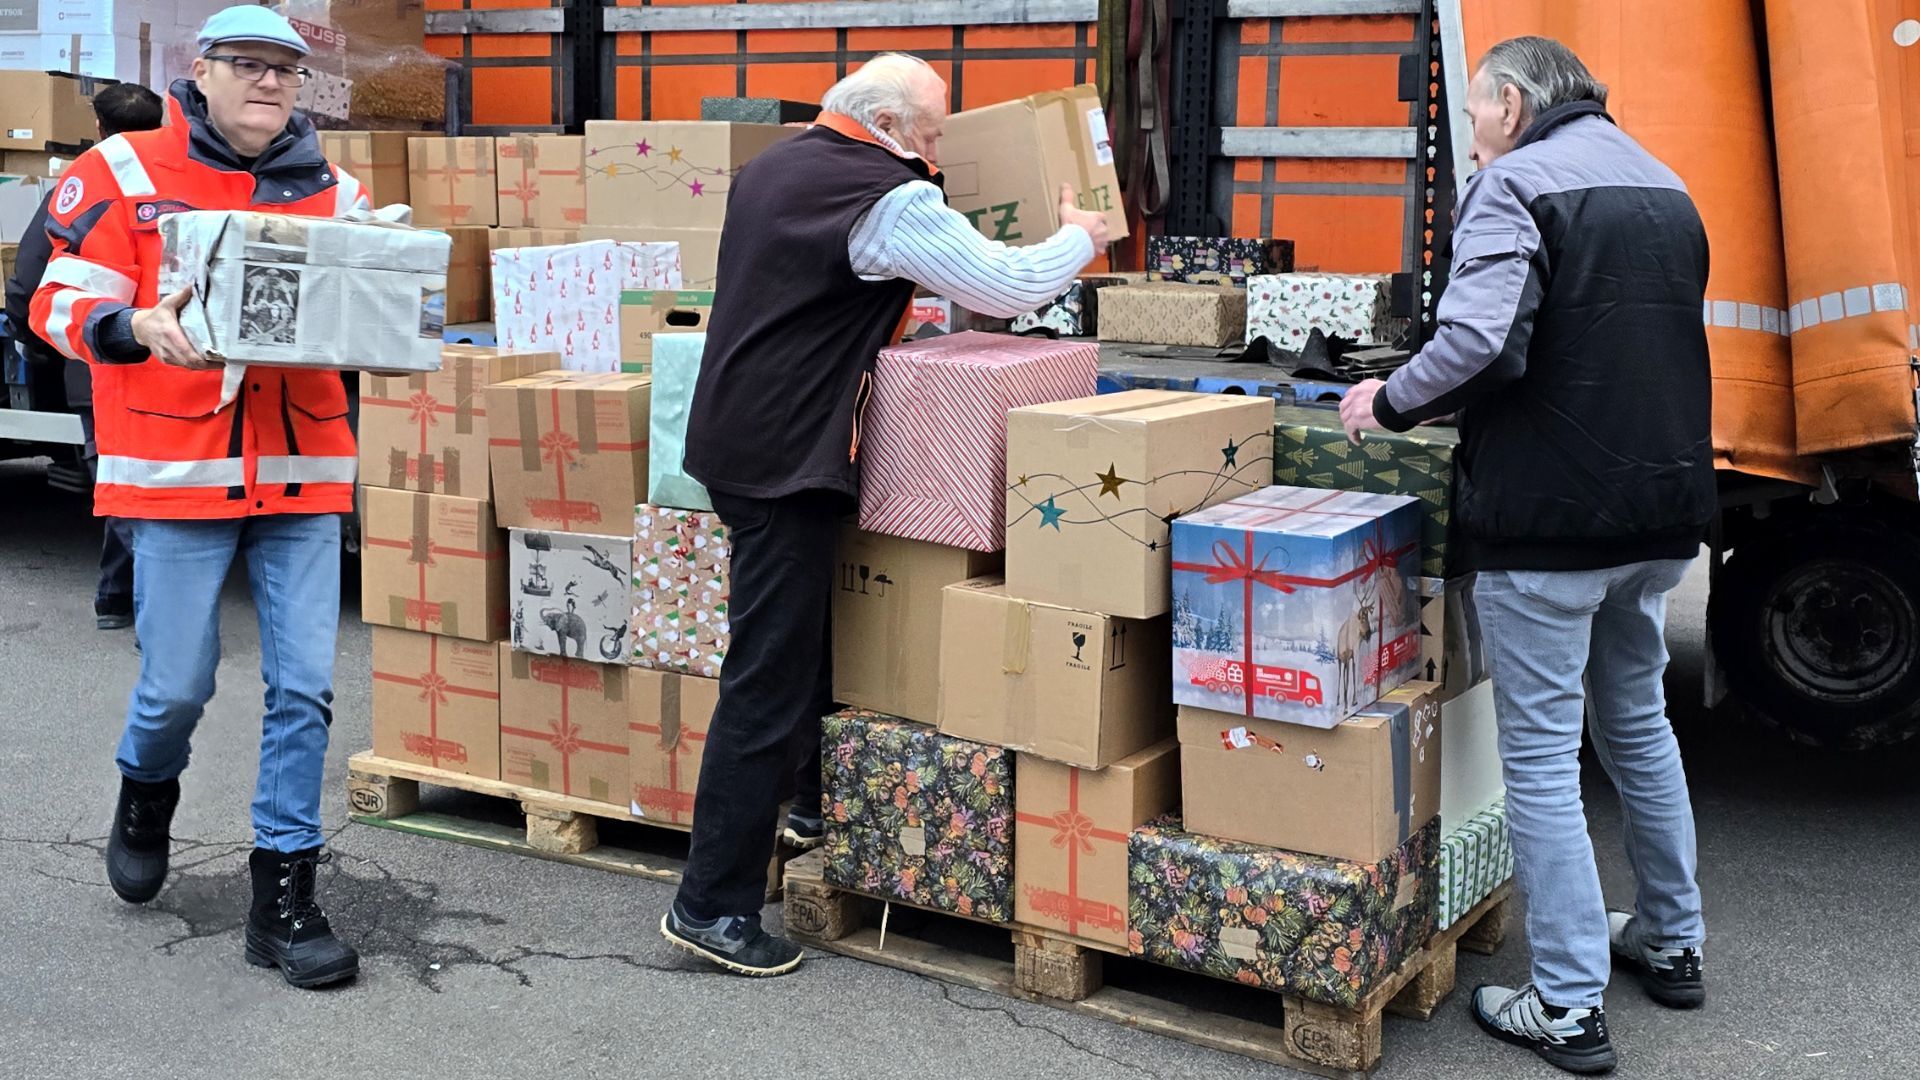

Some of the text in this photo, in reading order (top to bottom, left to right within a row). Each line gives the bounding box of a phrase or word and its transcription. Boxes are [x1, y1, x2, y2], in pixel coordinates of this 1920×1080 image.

[1067, 621, 1093, 631] FRAGILE
[1065, 661, 1092, 671] FRAGILE
[355, 791, 379, 809] EUR
